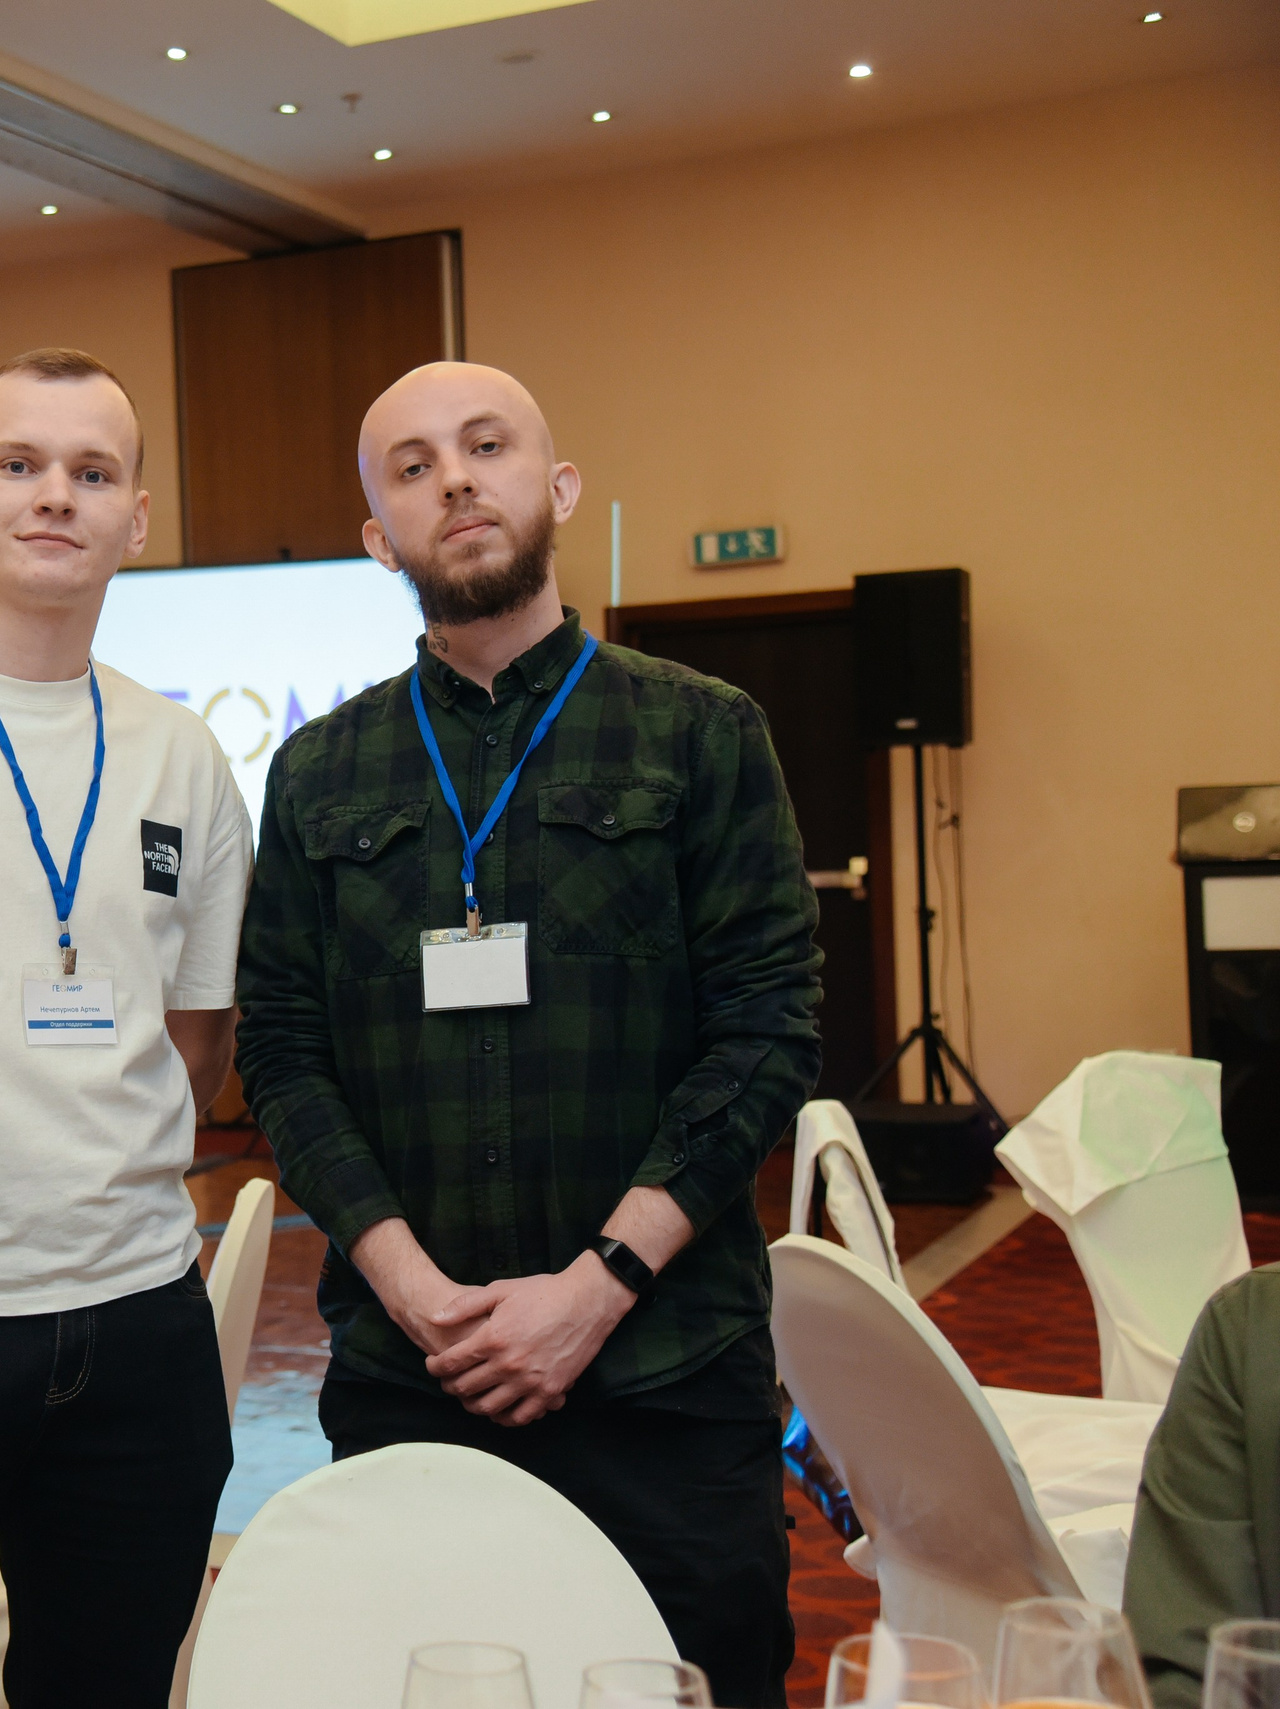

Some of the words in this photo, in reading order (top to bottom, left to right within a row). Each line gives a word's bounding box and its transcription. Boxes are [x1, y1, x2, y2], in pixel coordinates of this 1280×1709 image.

[154, 842, 169, 853] THE
[144, 851, 170, 863] NORTH
[152, 861, 170, 873] FACE
[52, 984, 83, 992] ГЕОМИР
